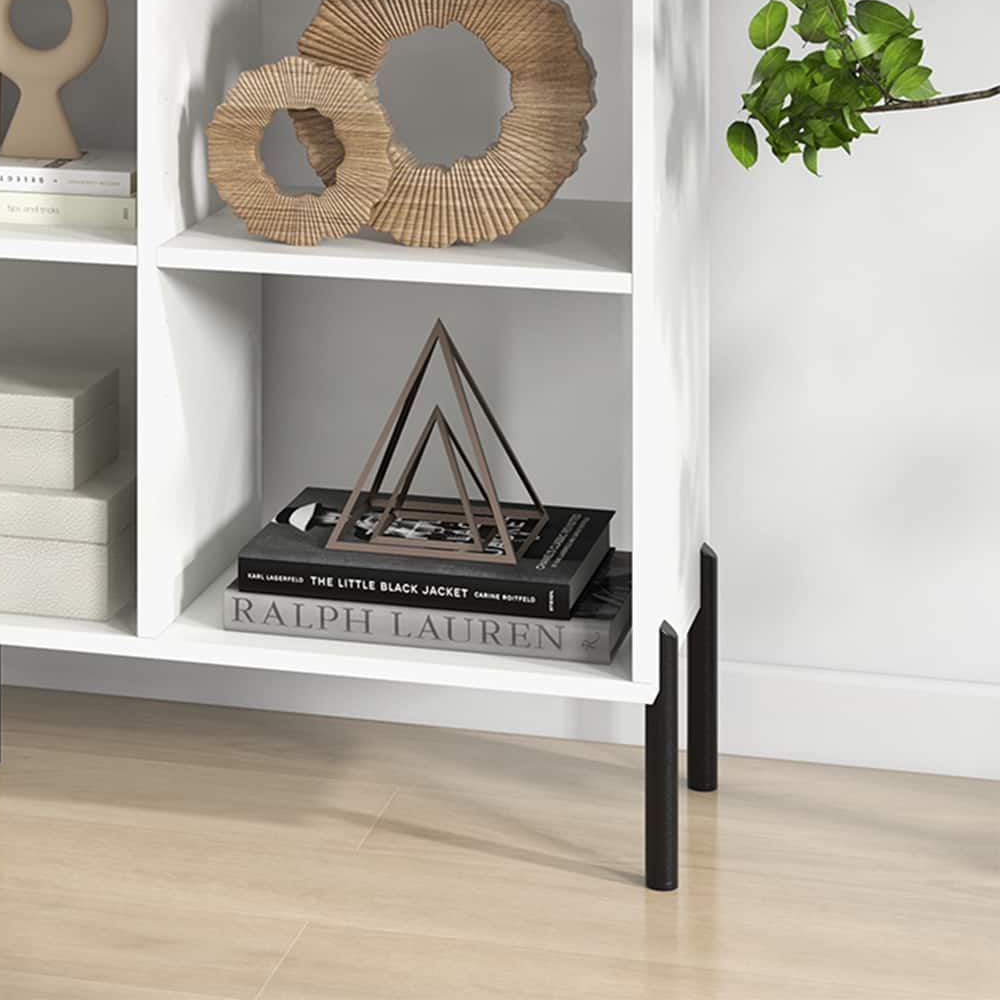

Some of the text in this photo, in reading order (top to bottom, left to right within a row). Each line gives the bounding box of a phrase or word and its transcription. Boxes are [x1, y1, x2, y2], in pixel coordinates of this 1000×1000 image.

[247, 572, 265, 581] KARL
[266, 573, 305, 584] LAGERFELD
[310, 574, 334, 588] THE
[337, 577, 377, 592] LITTLE
[379, 581, 420, 595] BLACK
[421, 584, 469, 599] JACKET
[472, 589, 501, 601] CARINE
[230, 595, 375, 637] RALPH
[390, 609, 567, 653] LAUREN
